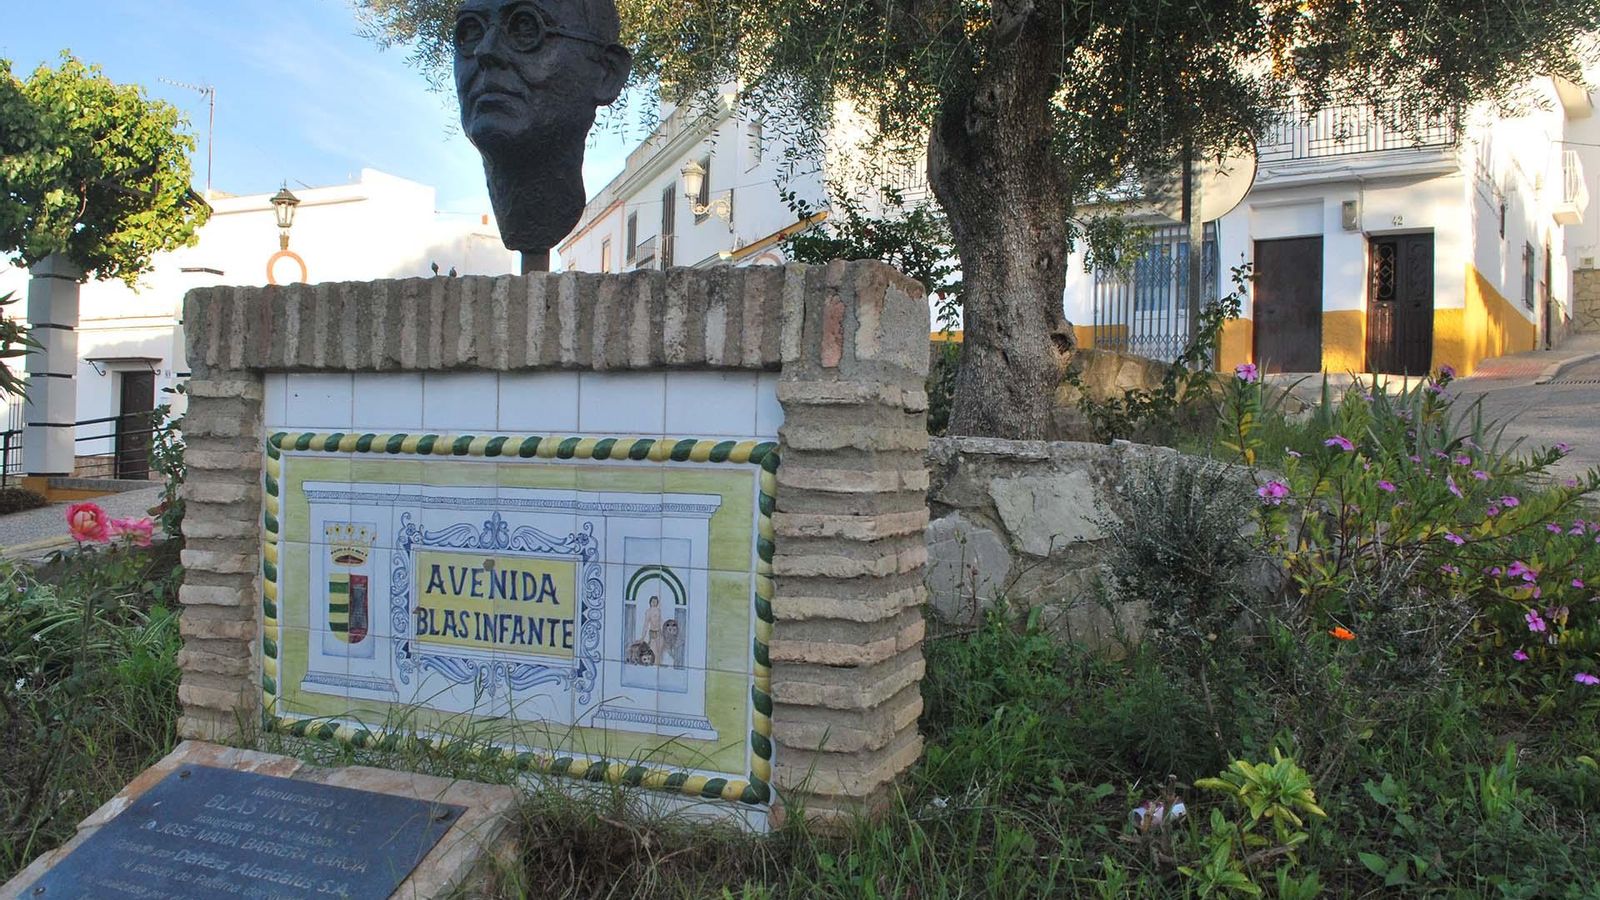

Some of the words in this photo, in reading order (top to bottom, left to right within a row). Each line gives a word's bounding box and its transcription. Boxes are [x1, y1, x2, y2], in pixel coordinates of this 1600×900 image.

[1392, 215, 1403, 226] 42
[425, 564, 560, 605] AVENIDA
[416, 606, 471, 638] BLAS
[474, 611, 574, 649] INFANTE
[204, 793, 263, 815] BLAS
[262, 802, 368, 835] INFANTE
[252, 787, 333, 808] Monumento
[194, 829, 240, 848] MARIA
[240, 838, 309, 860] BARRERA
[174, 849, 230, 870] Dehesa
[228, 861, 313, 889] Alandalus
[317, 879, 350, 897] S.A.
